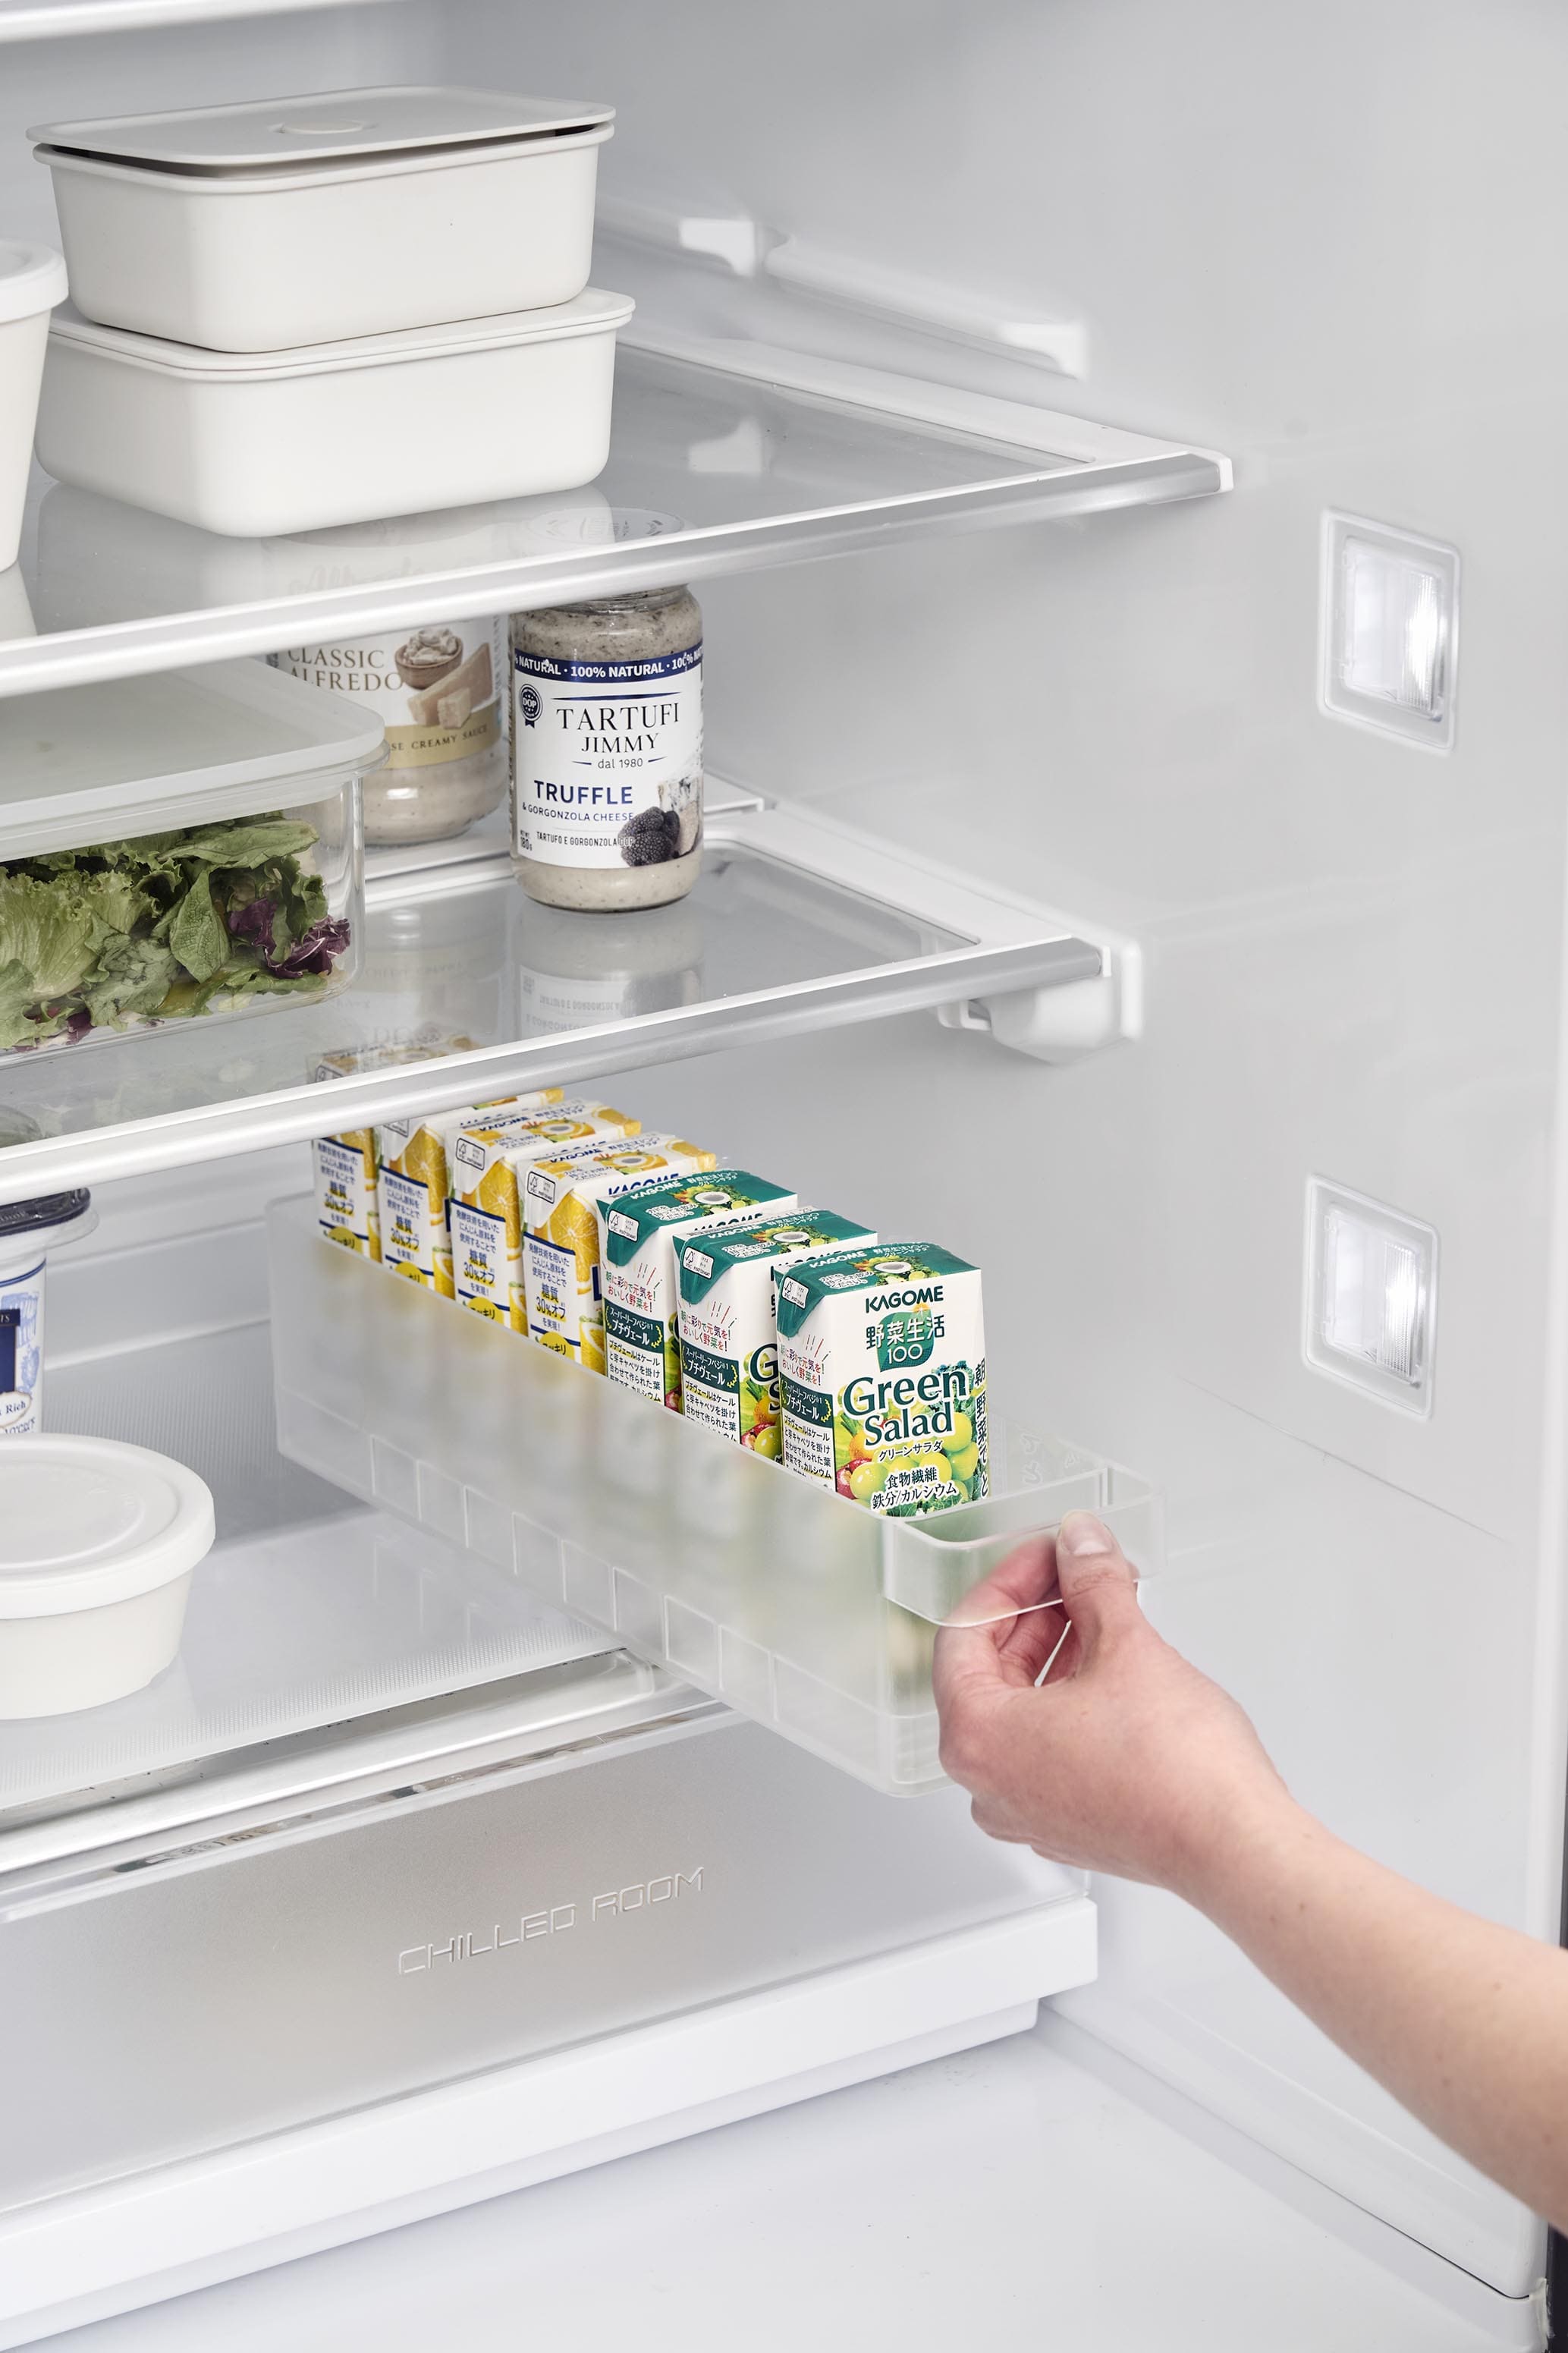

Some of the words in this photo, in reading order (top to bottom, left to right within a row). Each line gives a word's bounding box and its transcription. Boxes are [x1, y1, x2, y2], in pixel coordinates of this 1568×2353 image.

[288, 648, 385, 668] CLASSIC
[519, 655, 561, 675] NATURAL
[570, 665, 606, 678] 100%
[608, 662, 665, 678] NATURAL
[522, 697, 537, 709] DOP
[556, 702, 680, 731] TARTUFI
[411, 735, 457, 750] CREAMY
[461, 724, 488, 741] SAUCE
[581, 732, 659, 753] JIMMY
[597, 758, 615, 769] dal
[619, 757, 643, 769] 1980
[533, 779, 633, 805] TRUFFLE
[522, 801, 526, 810] &
[527, 805, 591, 822] GORGONZOLA
[593, 812, 634, 822] CHEESE
[536, 831, 563, 845] TARTUFO
[564, 836, 568, 845] E
[570, 837, 617, 847] GORGONZOLA
[630, 1181, 683, 1199] KAGOME
[708, 1224, 762, 1238] KAGOME
[809, 1251, 868, 1269] KAGOME
[866, 1285, 944, 1313] KAGOME
[866, 1313, 945, 1350] 野菜生活
[887, 1346, 923, 1364] 100
[843, 1369, 967, 1417] Green
[6, 1400, 26, 1414] Rich
[864, 1401, 953, 1446] Salad
[878, 1440, 943, 1462] グリーンサラダ
[886, 1467, 938, 1490] 食物繊維
[872, 1483, 958, 1509] 鉄分/カルシウム
[399, 1902, 577, 1975] CHILLED
[592, 1866, 705, 1923] ROOM
